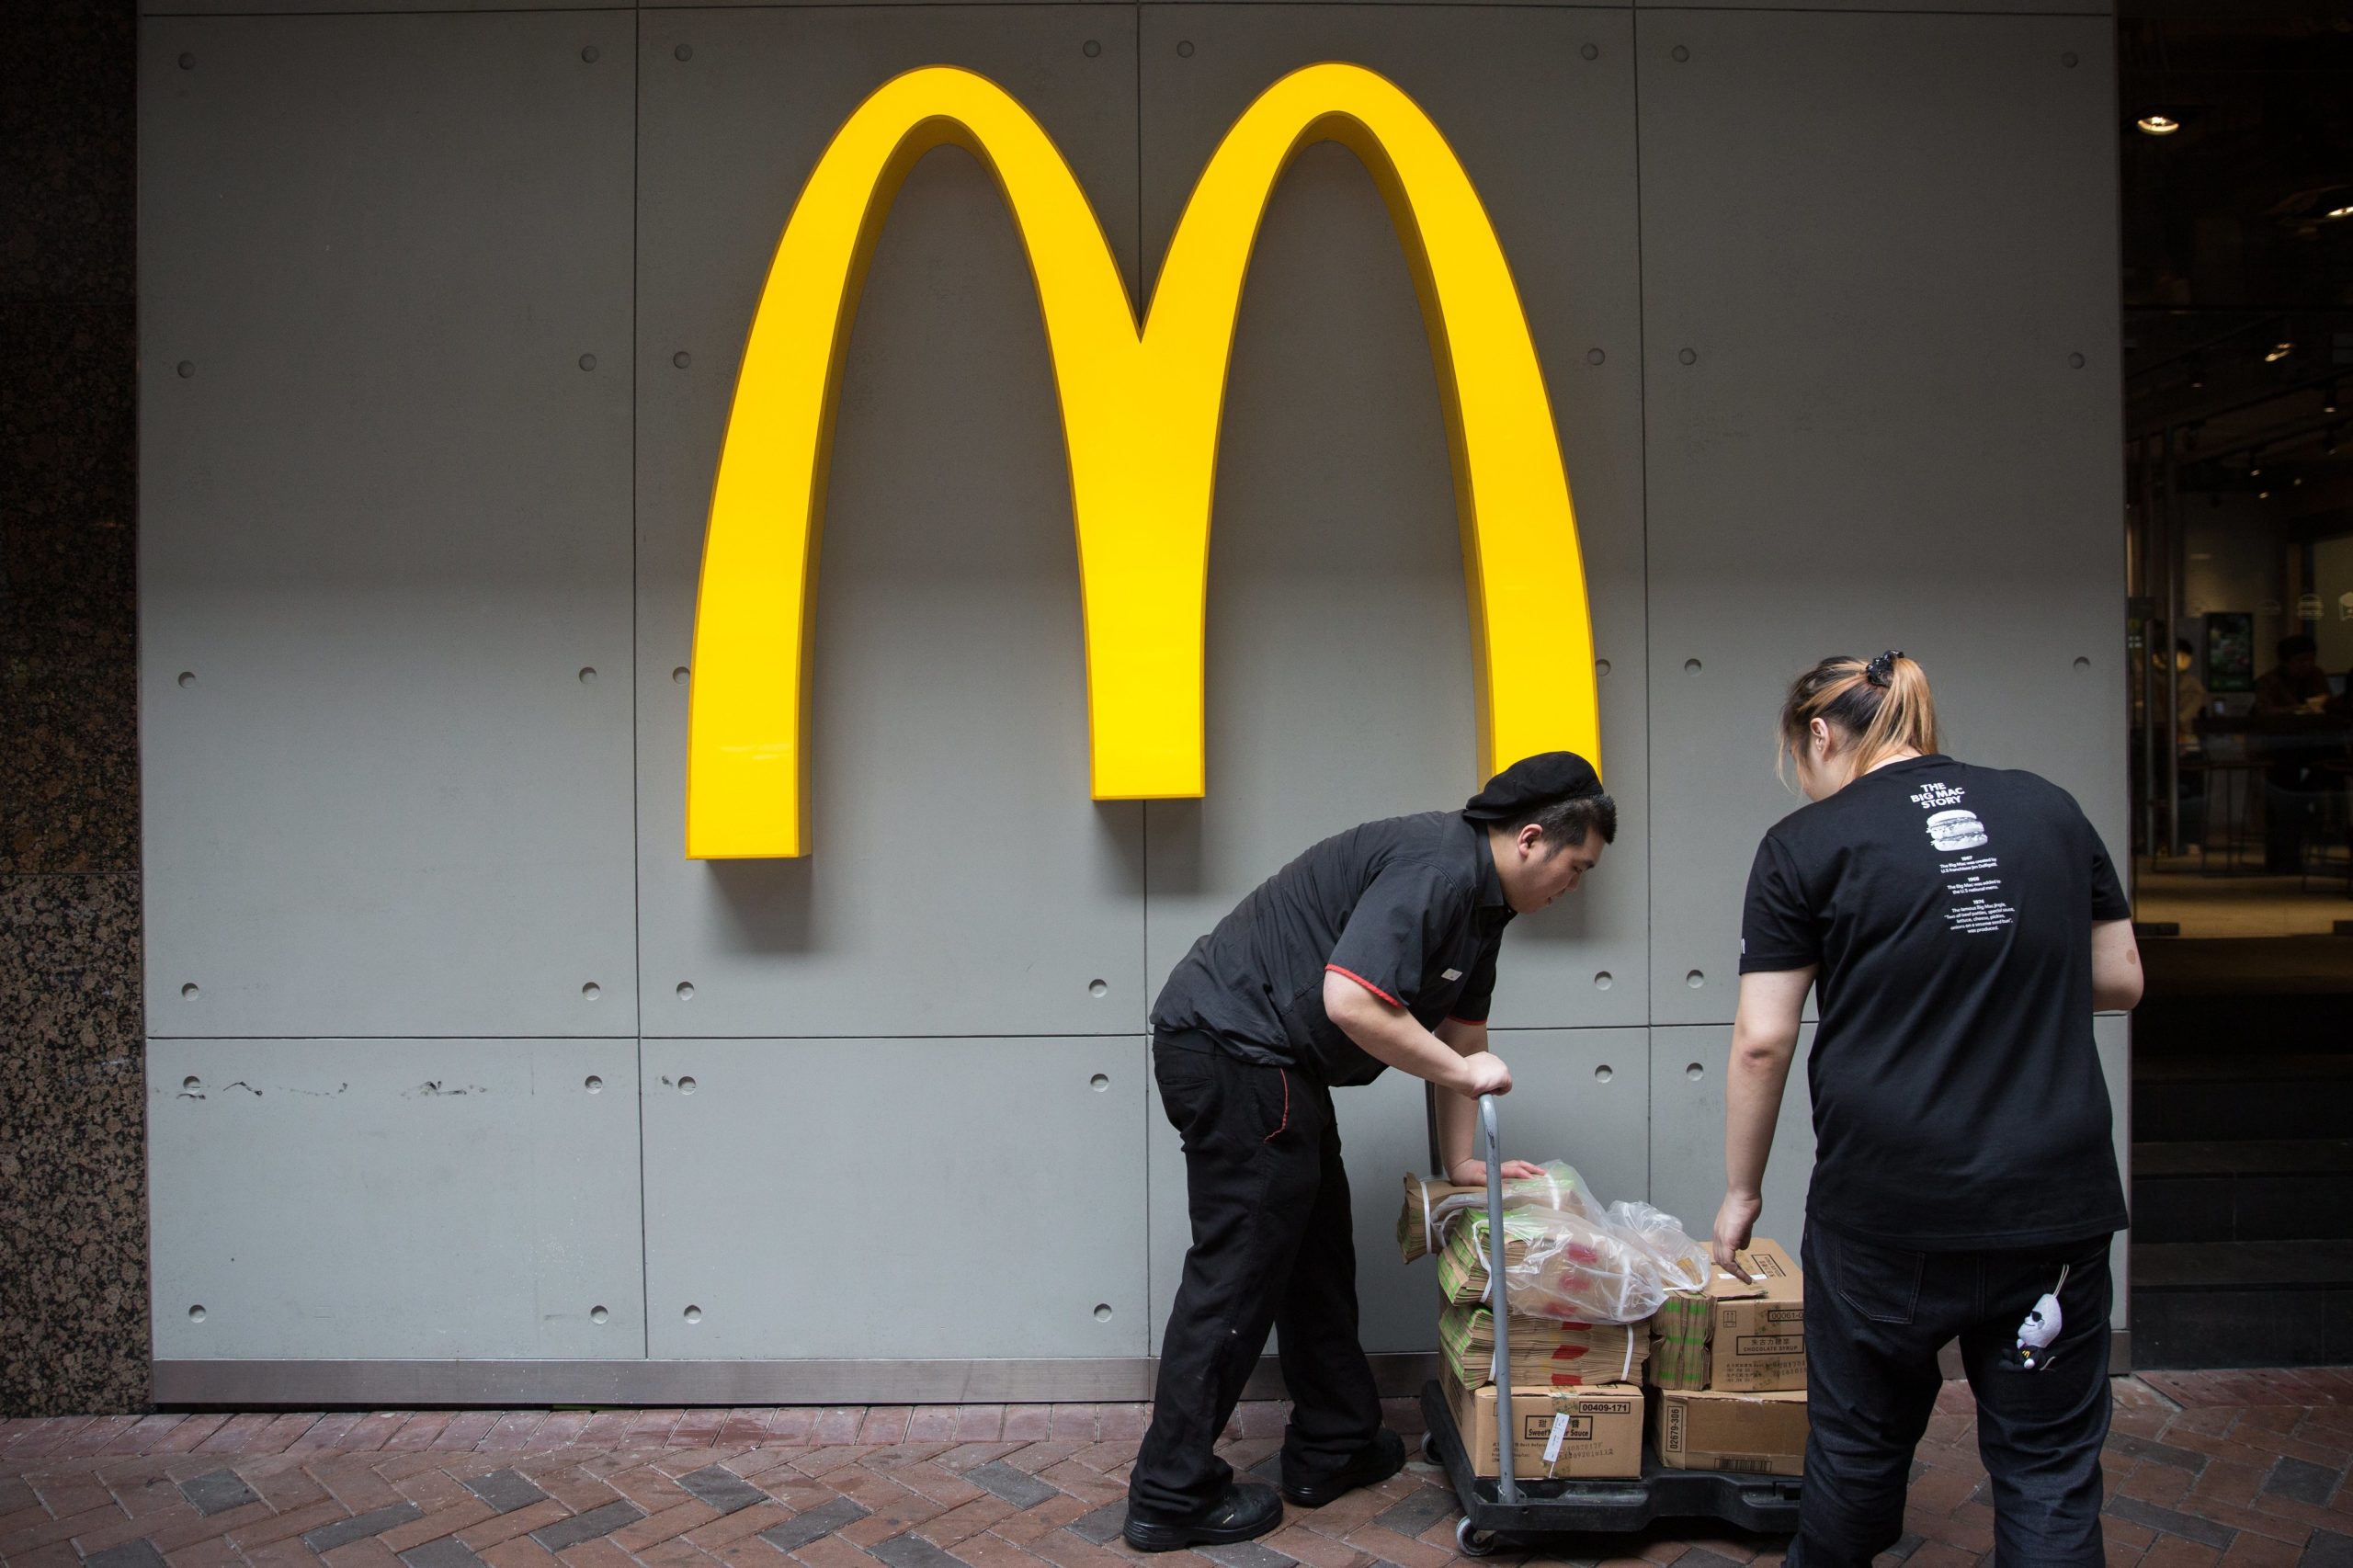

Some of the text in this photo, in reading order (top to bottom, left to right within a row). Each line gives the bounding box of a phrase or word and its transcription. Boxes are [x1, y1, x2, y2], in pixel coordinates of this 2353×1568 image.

[1920, 782, 1946, 792] THE
[1910, 787, 1965, 802] BIG MAC
[1921, 795, 1961, 809] STORY
[1583, 1403, 1627, 1412] 00409-171
[1670, 1409, 1679, 1449] 02679-306
